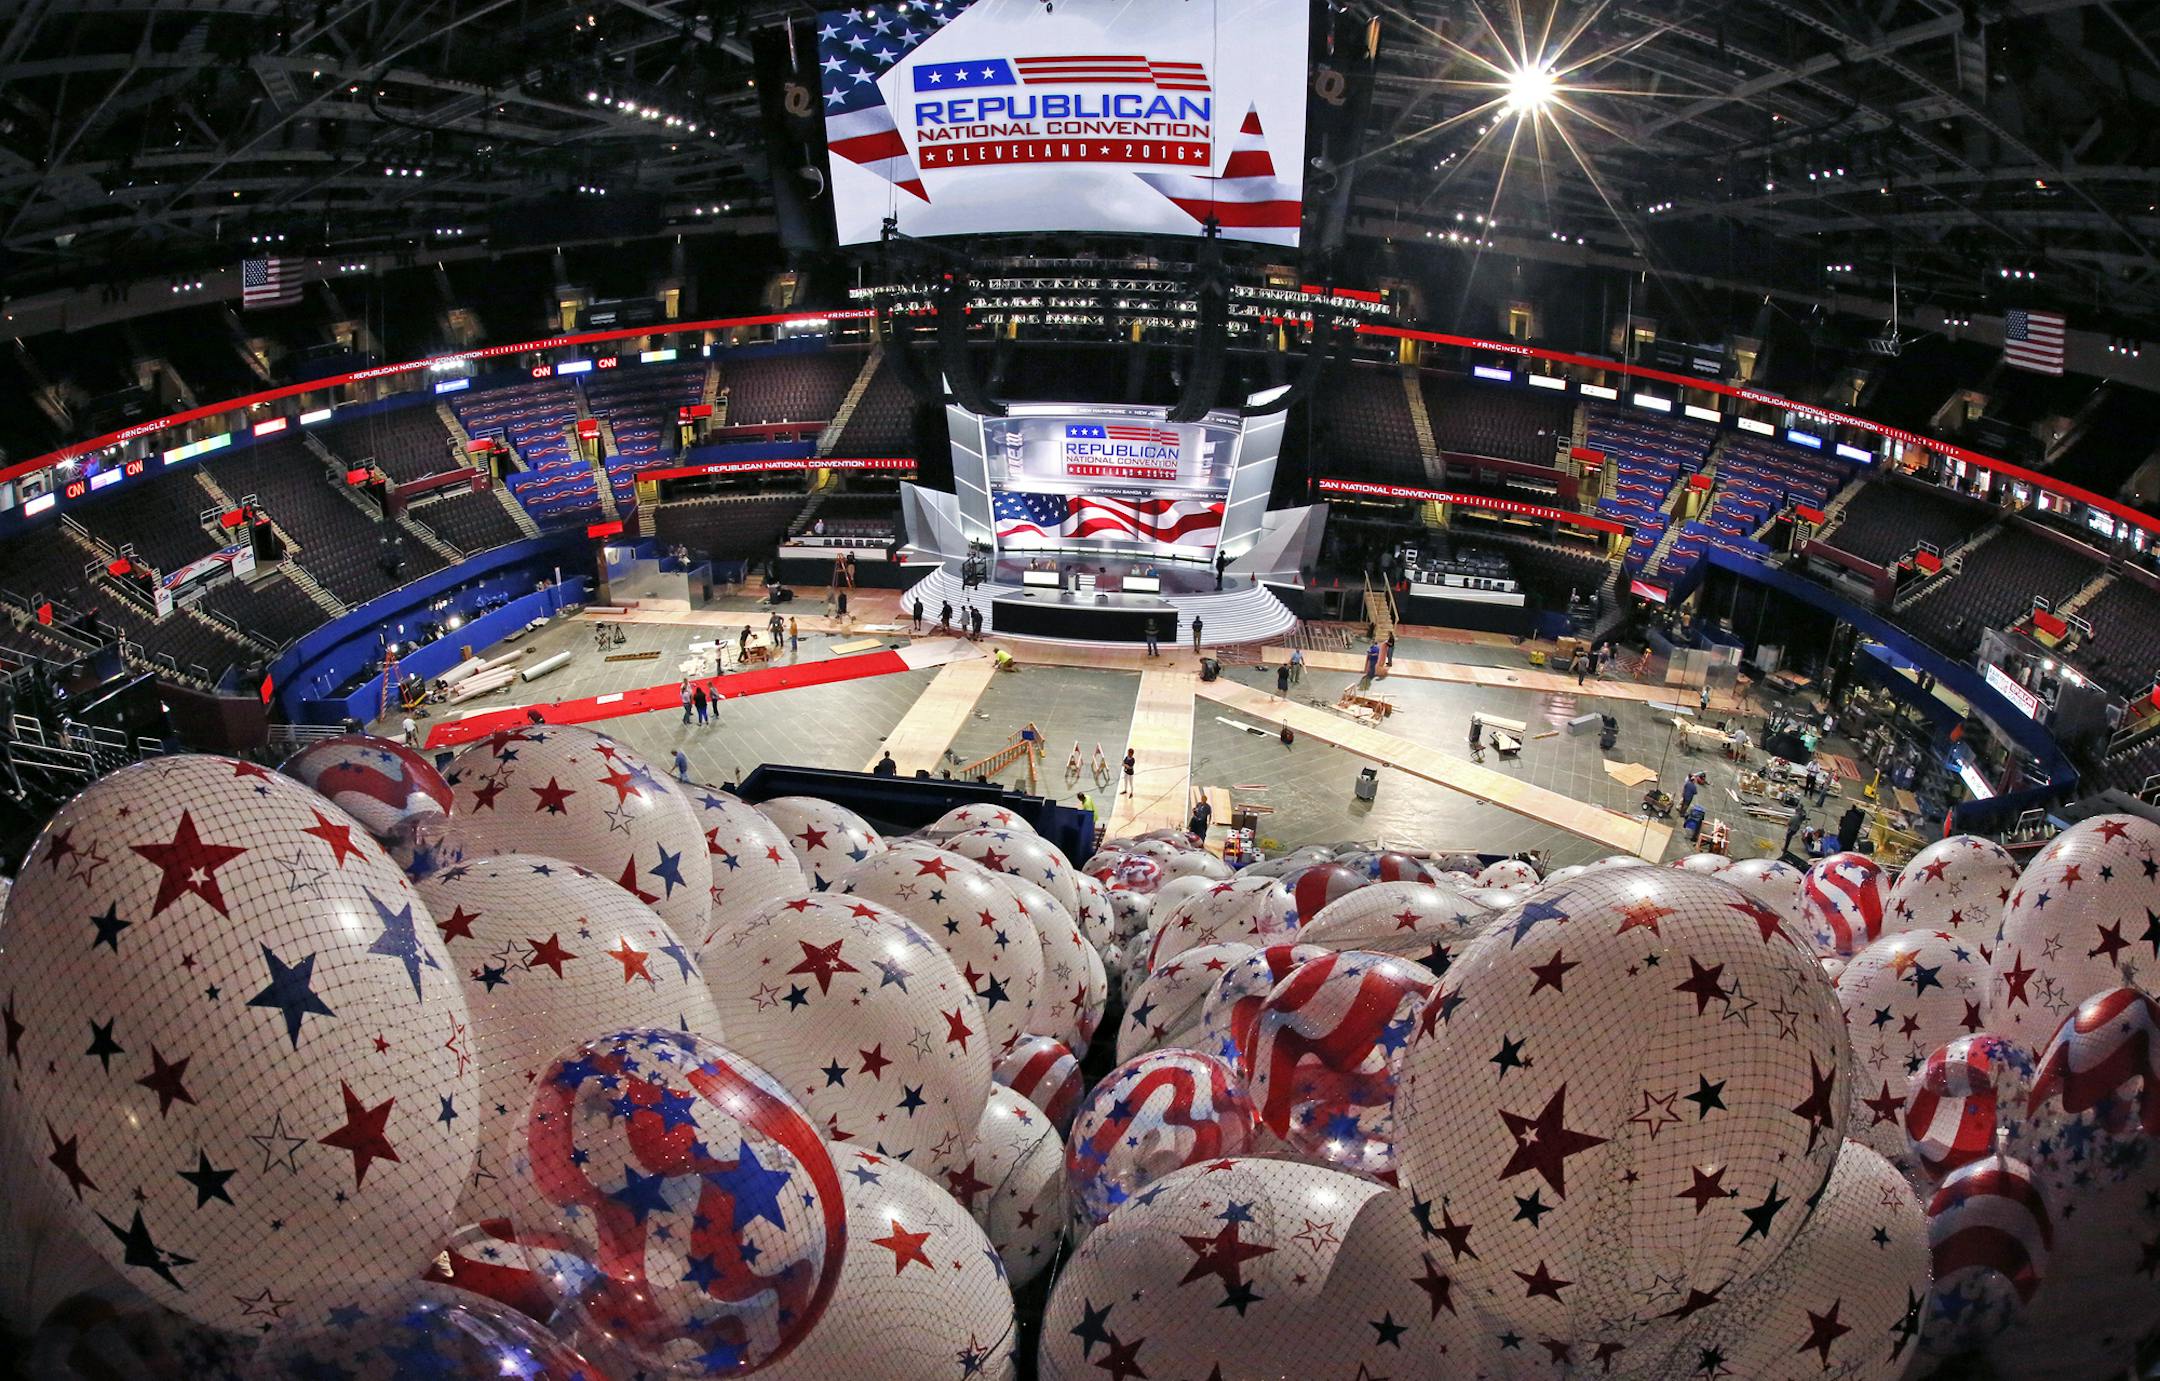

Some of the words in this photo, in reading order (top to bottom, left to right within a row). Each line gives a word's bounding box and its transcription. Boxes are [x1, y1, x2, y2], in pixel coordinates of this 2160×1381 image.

[915, 94, 1211, 126] REPUBLICAN
[917, 122, 1040, 143] NATIONAL
[1047, 121, 1209, 138] CONVENTION
[946, 142, 1088, 162] CLEVELAND
[1125, 143, 1186, 160] 2016
[353, 365, 399, 380] REPUBLICAN
[399, 359, 434, 371] NATIONAL
[434, 351, 484, 363] CONVENTION
[598, 357, 617, 368] CNN
[532, 366, 551, 378] CNN
[1741, 390, 1790, 408] REPUBLICAN
[1790, 403, 1828, 419] NATIONAL
[1828, 412, 1879, 432] CONVENTION
[1066, 443, 1179, 459] REPUBLICAN
[127, 460, 144, 476] CNN
[707, 461, 763, 473] REPUBLICAN
[765, 459, 808, 469] NATIONAL
[808, 458, 865, 468] CONVENTION
[1066, 456, 1114, 464] NATIONAL
[1117, 457, 1178, 467] CONVENTION
[1076, 466, 1133, 476] CLEVELAND
[67, 480, 86, 498] CNN
[1341, 481, 1390, 494] NATIONAL
[1391, 486, 1454, 501] CONVENTION
[1463, 496, 1519, 512] CLEVELAND
[1530, 507, 1555, 518] 2016
